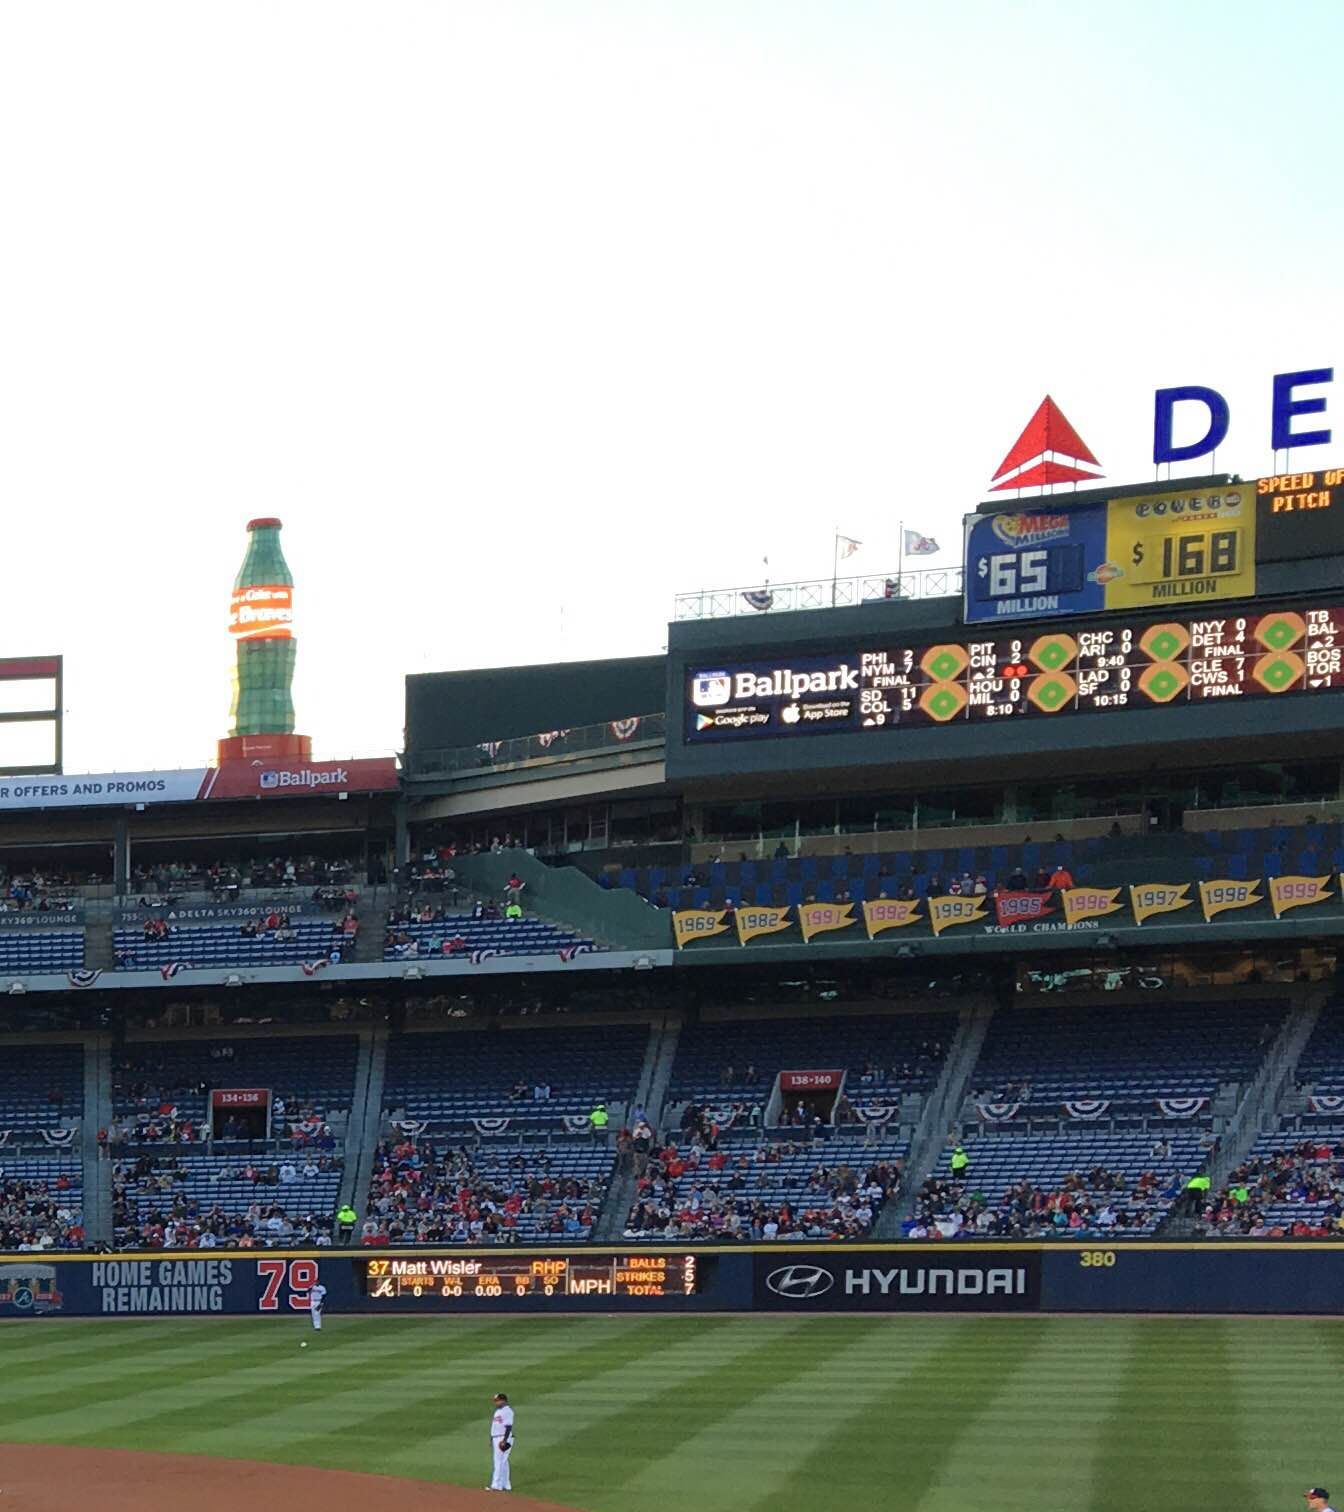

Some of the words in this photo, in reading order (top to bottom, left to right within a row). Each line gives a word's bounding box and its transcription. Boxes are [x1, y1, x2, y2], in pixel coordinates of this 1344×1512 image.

[1153, 367, 1334, 464] DE
[1258, 473, 1313, 494] SPEED
[1273, 490, 1330, 513] PITCH
[1163, 530, 1237, 579] 168
[1152, 580, 1216, 599] MILLION
[997, 595, 1059, 615] MILLION
[1308, 610, 1329, 623] TB
[1192, 620, 1226, 635] NYY
[1235, 618, 1246, 631] 0
[1308, 622, 1338, 636] BAL
[1079, 631, 1114, 646] CHC
[1121, 629, 1132, 642] 0
[1192, 633, 1224, 647] DET
[1235, 630, 1245, 643] 4
[1324, 636, 1334, 648] 2
[970, 642, 995, 656] PIT
[1012, 640, 1022, 652] 0
[1079, 644, 1105, 658] ARI
[1121, 641, 1131, 653] 0
[1204, 645, 1245, 658] FINAL
[1307, 649, 1341, 663] BOS
[862, 652, 887, 665] PHI
[904, 650, 913, 662] 2
[970, 654, 996, 668] CIN
[1011, 652, 1021, 664] 2
[1097, 655, 1125, 668] 9:40
[862, 664, 895, 677] NYM
[904, 662, 912, 673] 7
[1191, 659, 1222, 674] CLE
[1235, 658, 1245, 670] 7
[1307, 661, 1341, 675] TOR
[734, 664, 859, 699] Ballpark
[873, 675, 910, 688] FINAL
[1079, 670, 1110, 684] LAD
[1121, 668, 1131, 680] 0
[1191, 671, 1228, 685] CWS
[969, 680, 1003, 693] HOU
[1011, 678, 1021, 690] 0
[1078, 682, 1099, 696] SF
[1120, 679, 1131, 692] 0
[1203, 683, 1243, 697] FINAL
[861, 690, 882, 702] SD
[900, 687, 916, 699] 11
[969, 693, 994, 705] MIL
[1010, 690, 1020, 702] 0
[1093, 694, 1128, 706] 10:15
[804, 709, 823, 720] App
[823, 708, 849, 719] Store
[861, 701, 891, 713] COL
[902, 699, 912, 711] 5
[986, 704, 1013, 716] 8:10
[715, 714, 748, 727] Google
[749, 713, 770, 725] play
[279, 767, 348, 788] Ballpark
[14, 783, 69, 798] OFFERS
[72, 781, 103, 796] AND
[107, 779, 166, 793] PROMOS
[1136, 890, 1179, 908] 1997
[1206, 886, 1248, 904] 1998
[1275, 883, 1318, 901] 1999
[935, 902, 974, 918] 1993
[1000, 897, 1042, 916] 1995
[1068, 894, 1110, 911] 1996
[36, 914, 77, 925] LOUNGE
[178, 909, 214, 919] DELTA
[259, 904, 302, 916] LOUNGE
[805, 908, 842, 926] 1991
[869, 904, 907, 921] 1992
[678, 917, 716, 934] 1969
[740, 912, 779, 929] 1982
[629, 1258, 666, 1269] BALLS
[684, 1256, 695, 1269] 2
[1079, 1251, 1117, 1267] 380
[91, 1260, 152, 1287] HOME
[158, 1259, 233, 1286] GAMES
[368, 1262, 389, 1275] 37
[391, 1260, 426, 1275] Matt
[429, 1260, 482, 1275] Wisler
[532, 1261, 566, 1274] RHP
[401, 1277, 435, 1287] STARTS
[443, 1277, 463, 1287] W-L
[478, 1276, 499, 1286] ERA
[543, 1275, 559, 1286] SO
[616, 1271, 666, 1283] STRIKES
[684, 1269, 695, 1282] 5
[844, 1268, 1026, 1295] HYUNDAI
[256, 1260, 319, 1311] 79
[441, 1285, 463, 1298] 0-0
[474, 1285, 502, 1298] 0.00
[570, 1279, 611, 1295] MPH
[627, 1285, 665, 1296] TOTAL
[683, 1283, 695, 1296] 7
[101, 1286, 223, 1313] REMAINING
